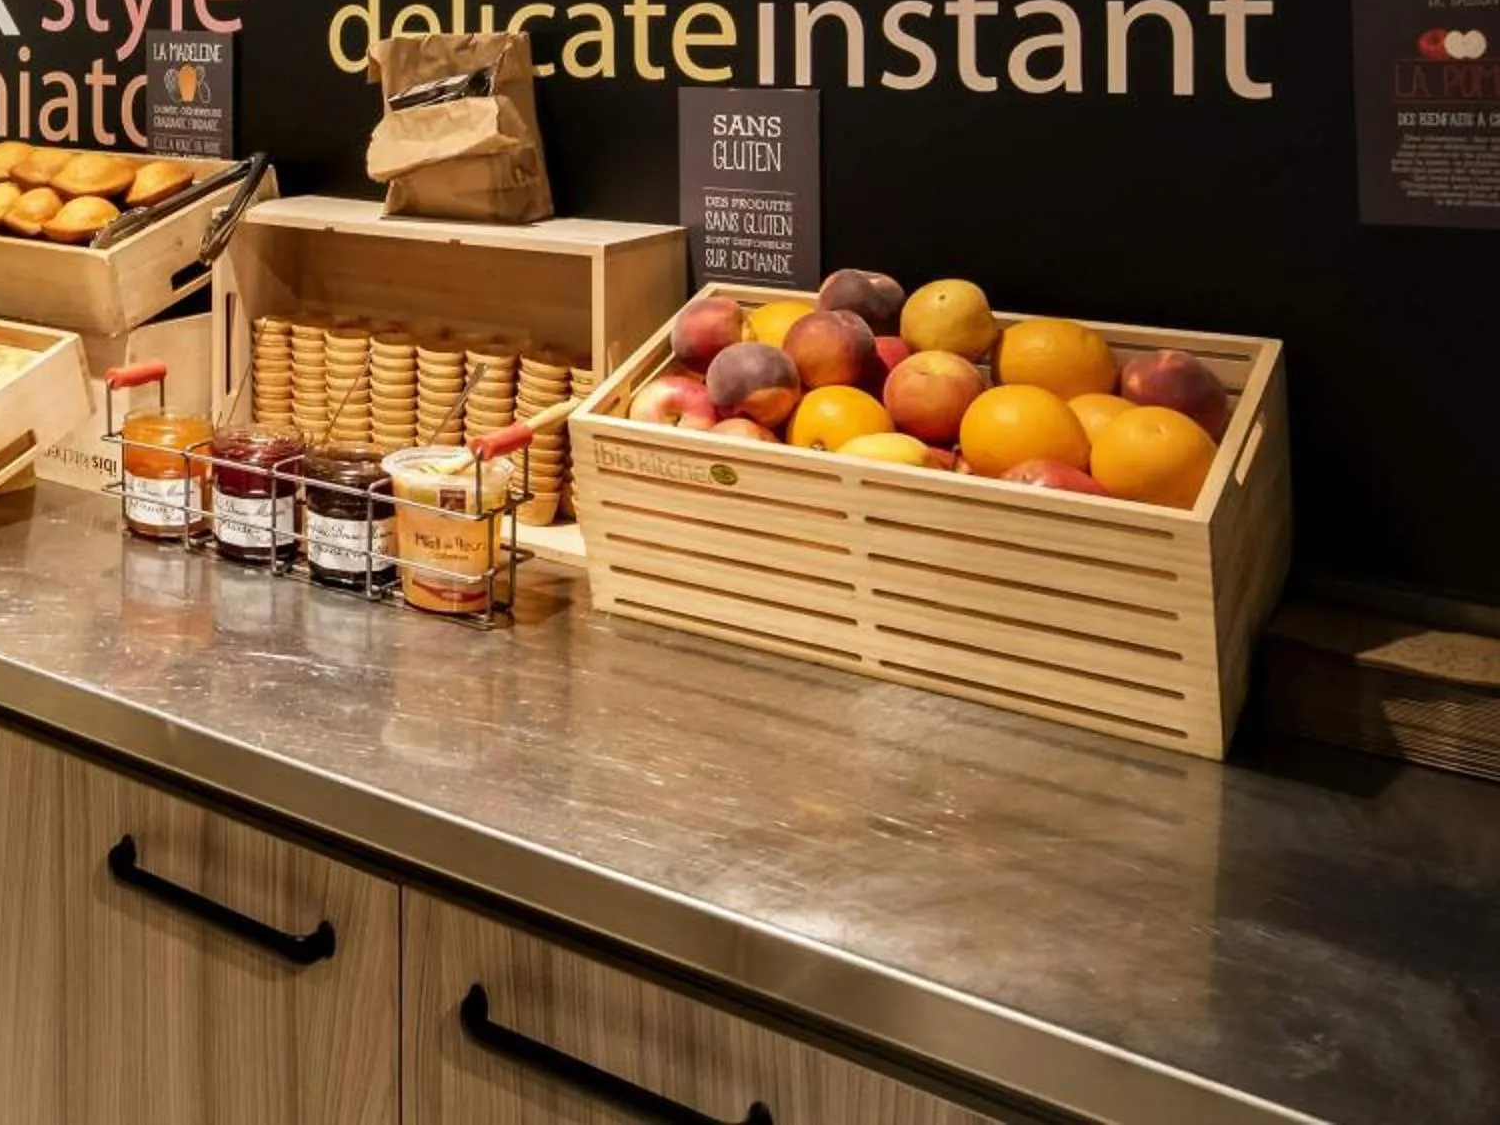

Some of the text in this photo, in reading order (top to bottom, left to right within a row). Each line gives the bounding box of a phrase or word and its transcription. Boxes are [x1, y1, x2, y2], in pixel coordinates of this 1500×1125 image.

[153, 43, 224, 63] LA MADELEINE
[713, 114, 781, 137] SANS
[713, 140, 782, 172] GLUTEN
[705, 196, 793, 212] DES PRODUITS
[705, 210, 793, 236] SANS GLUTEN
[705, 248, 794, 274] SUR DEMANDE
[92, 456, 117, 478] ibis
[593, 442, 634, 470] ibis
